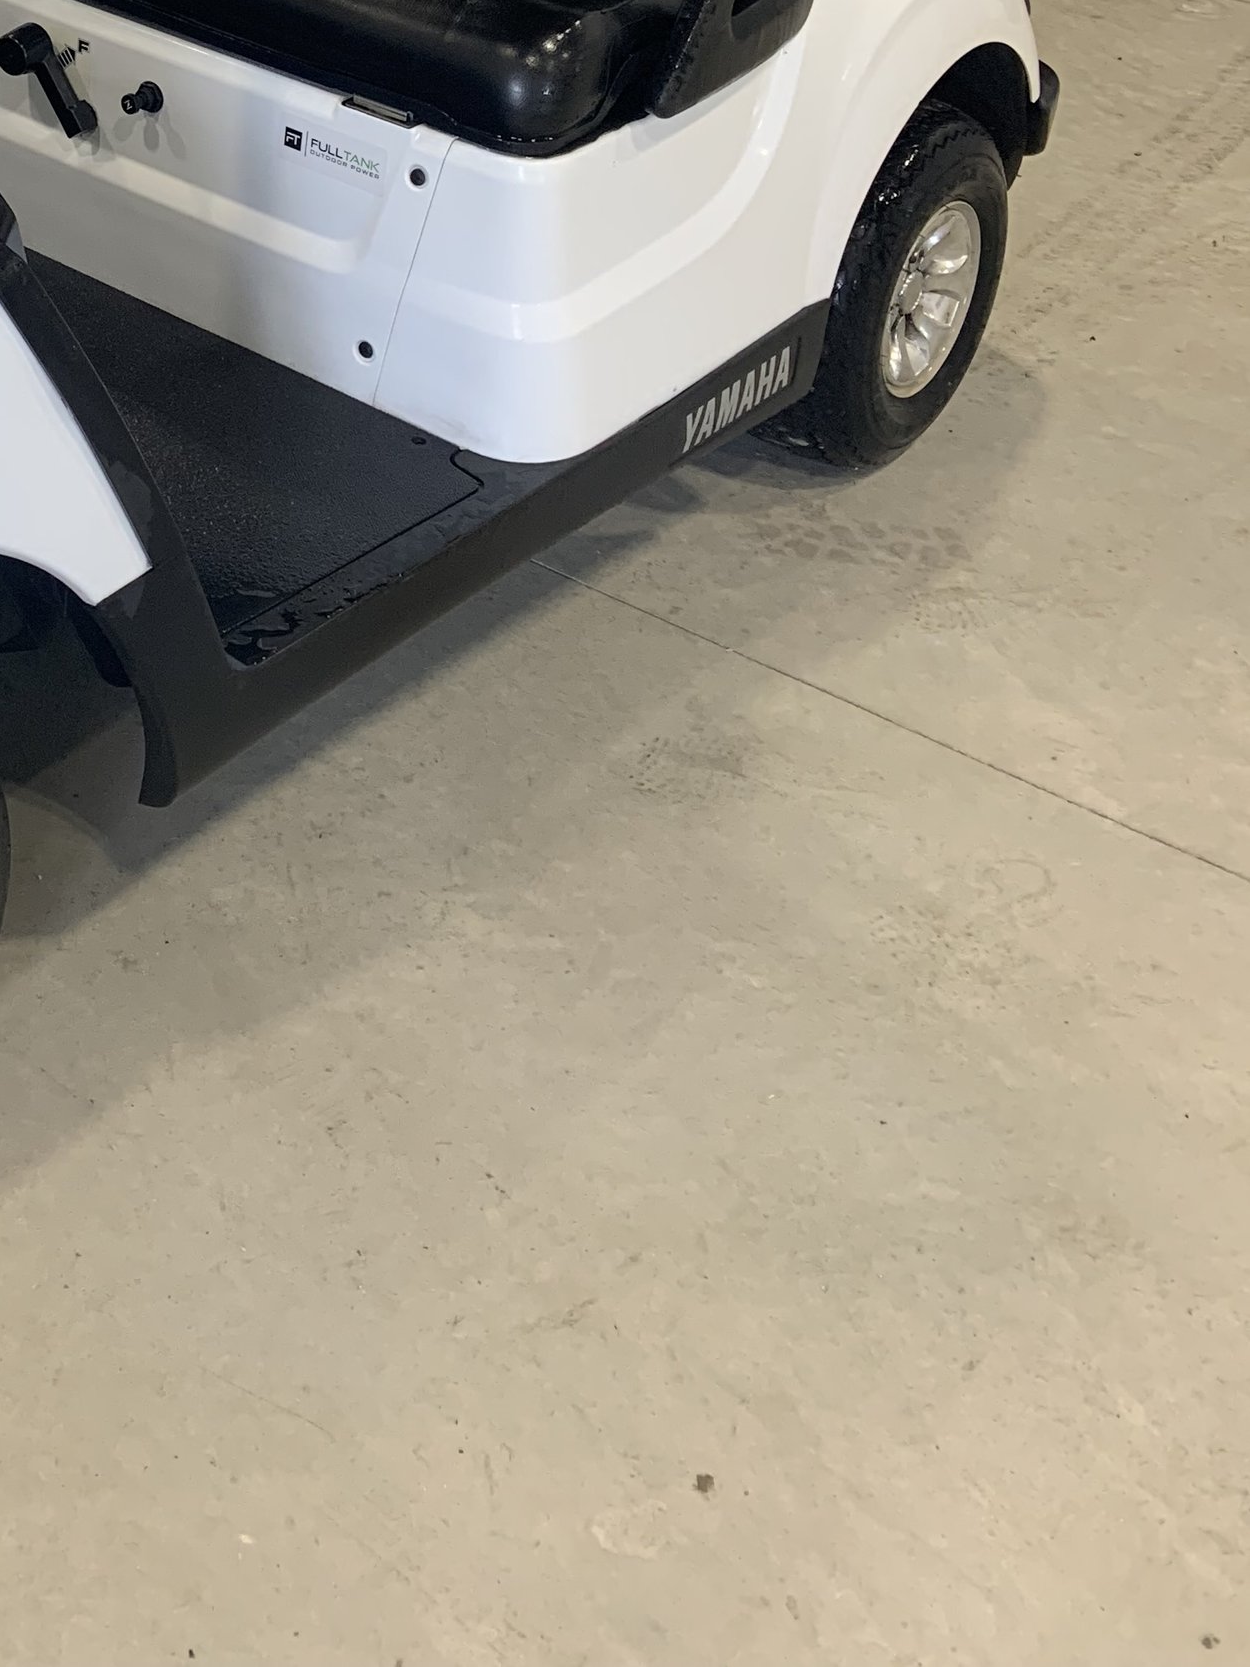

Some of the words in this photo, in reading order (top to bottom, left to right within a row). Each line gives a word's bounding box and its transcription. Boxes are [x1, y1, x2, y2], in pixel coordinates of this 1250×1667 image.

[78, 39, 90, 53] F
[310, 138, 380, 173] FULLTANK
[310, 149, 348, 167] OUTDOOR
[350, 164, 380, 180] POWER
[682, 346, 790, 454] YAMAHA
